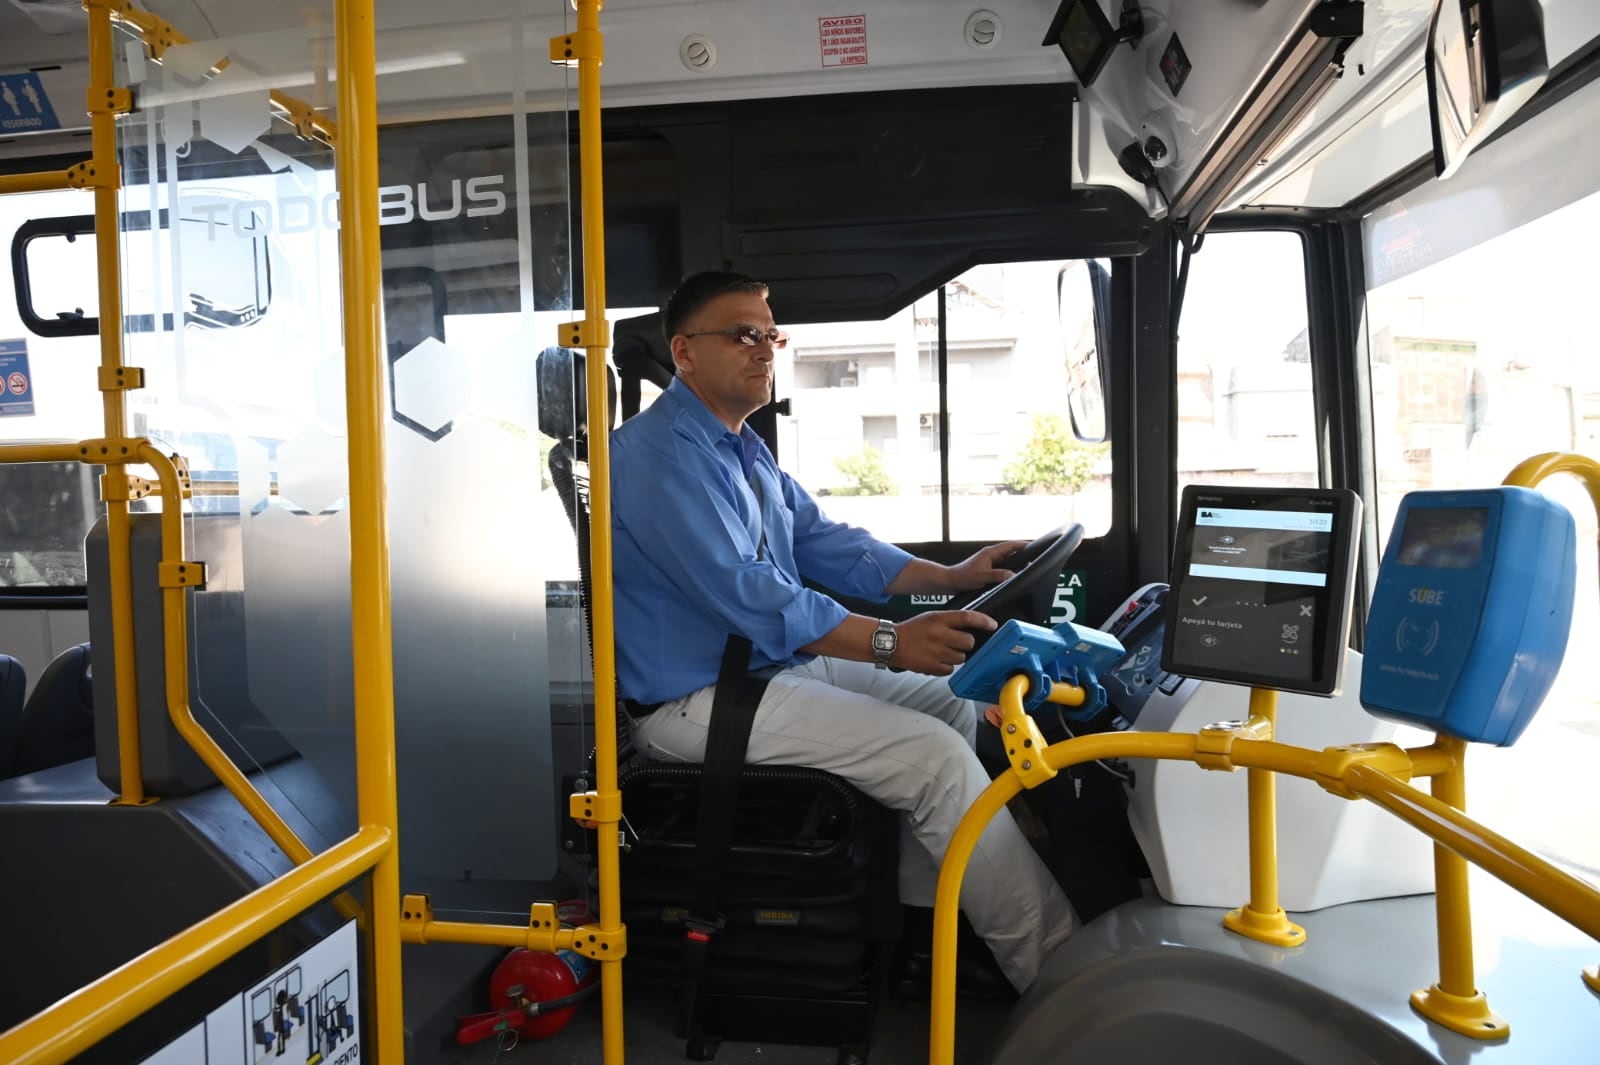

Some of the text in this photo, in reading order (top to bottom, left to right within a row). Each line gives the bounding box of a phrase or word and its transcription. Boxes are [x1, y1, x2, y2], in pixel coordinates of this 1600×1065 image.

[823, 18, 862, 26] AVISO
[1408, 586, 1444, 606] SUBE
[1050, 587, 1077, 624] 5
[1217, 620, 1243, 629] tarjeta
